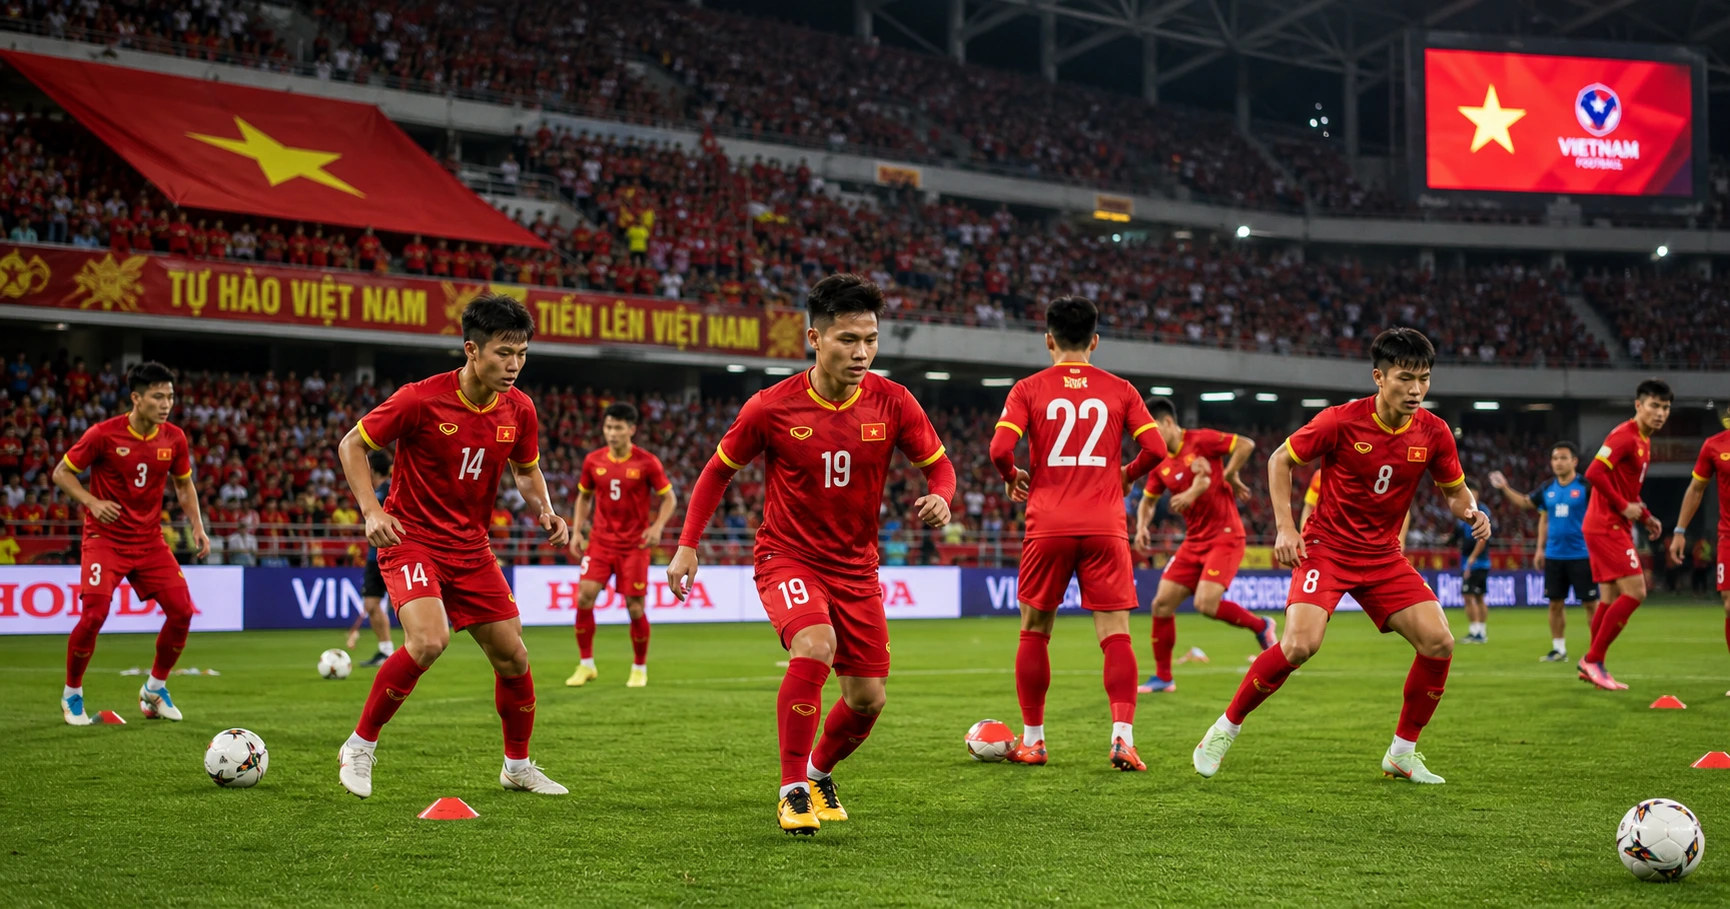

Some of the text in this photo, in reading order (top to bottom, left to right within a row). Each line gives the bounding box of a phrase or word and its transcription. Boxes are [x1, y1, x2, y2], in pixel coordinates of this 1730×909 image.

[1557, 136, 1640, 159] VIETNAM
[168, 267, 428, 327] TỰ HÀO VIỆT NAM
[536, 293, 760, 351] TIẾN LÊN VIỆT NAM
[1046, 397, 1109, 468] 22
[134, 463, 148, 488] 3
[458, 447, 485, 480] 14
[821, 450, 851, 488] 19
[609, 478, 621, 501] 5
[1373, 464, 1393, 495] 8
[580, 555, 592, 576] 5
[1626, 548, 1639, 569] 3
[88, 562, 102, 586] 3
[400, 562, 429, 591] 14
[1302, 568, 1321, 594] 8
[291, 577, 389, 619] VIN
[777, 577, 810, 610] 19
